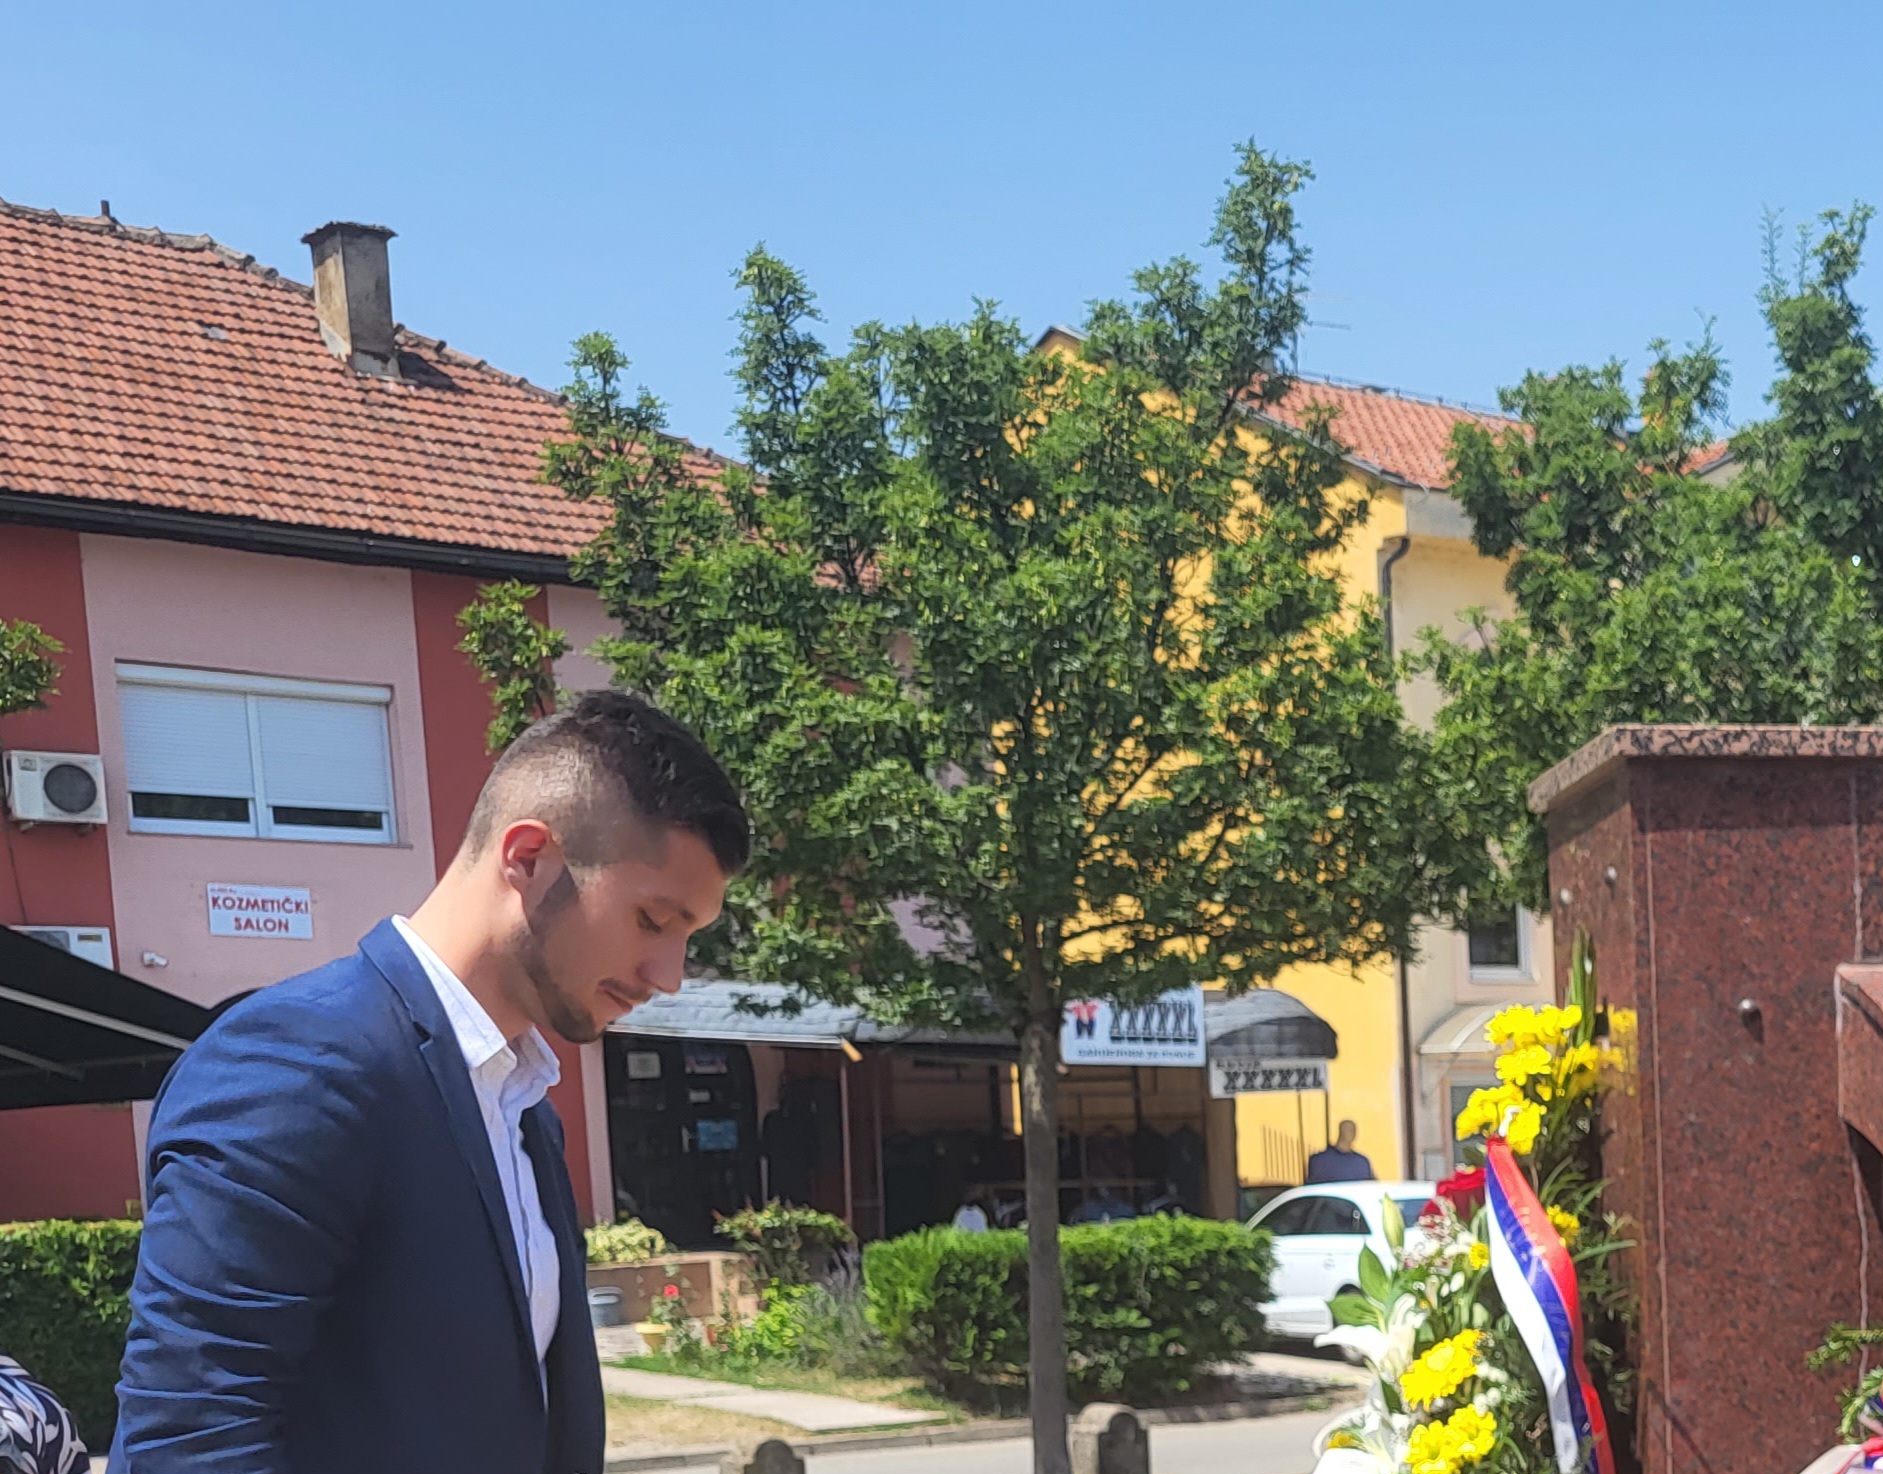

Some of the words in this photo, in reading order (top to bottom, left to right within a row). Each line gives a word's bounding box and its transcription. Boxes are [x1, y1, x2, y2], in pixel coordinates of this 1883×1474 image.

[211, 895, 309, 915] KOZMETIČKI
[234, 916, 290, 933] SALON
[1223, 1067, 1323, 1091] XXXXXL
